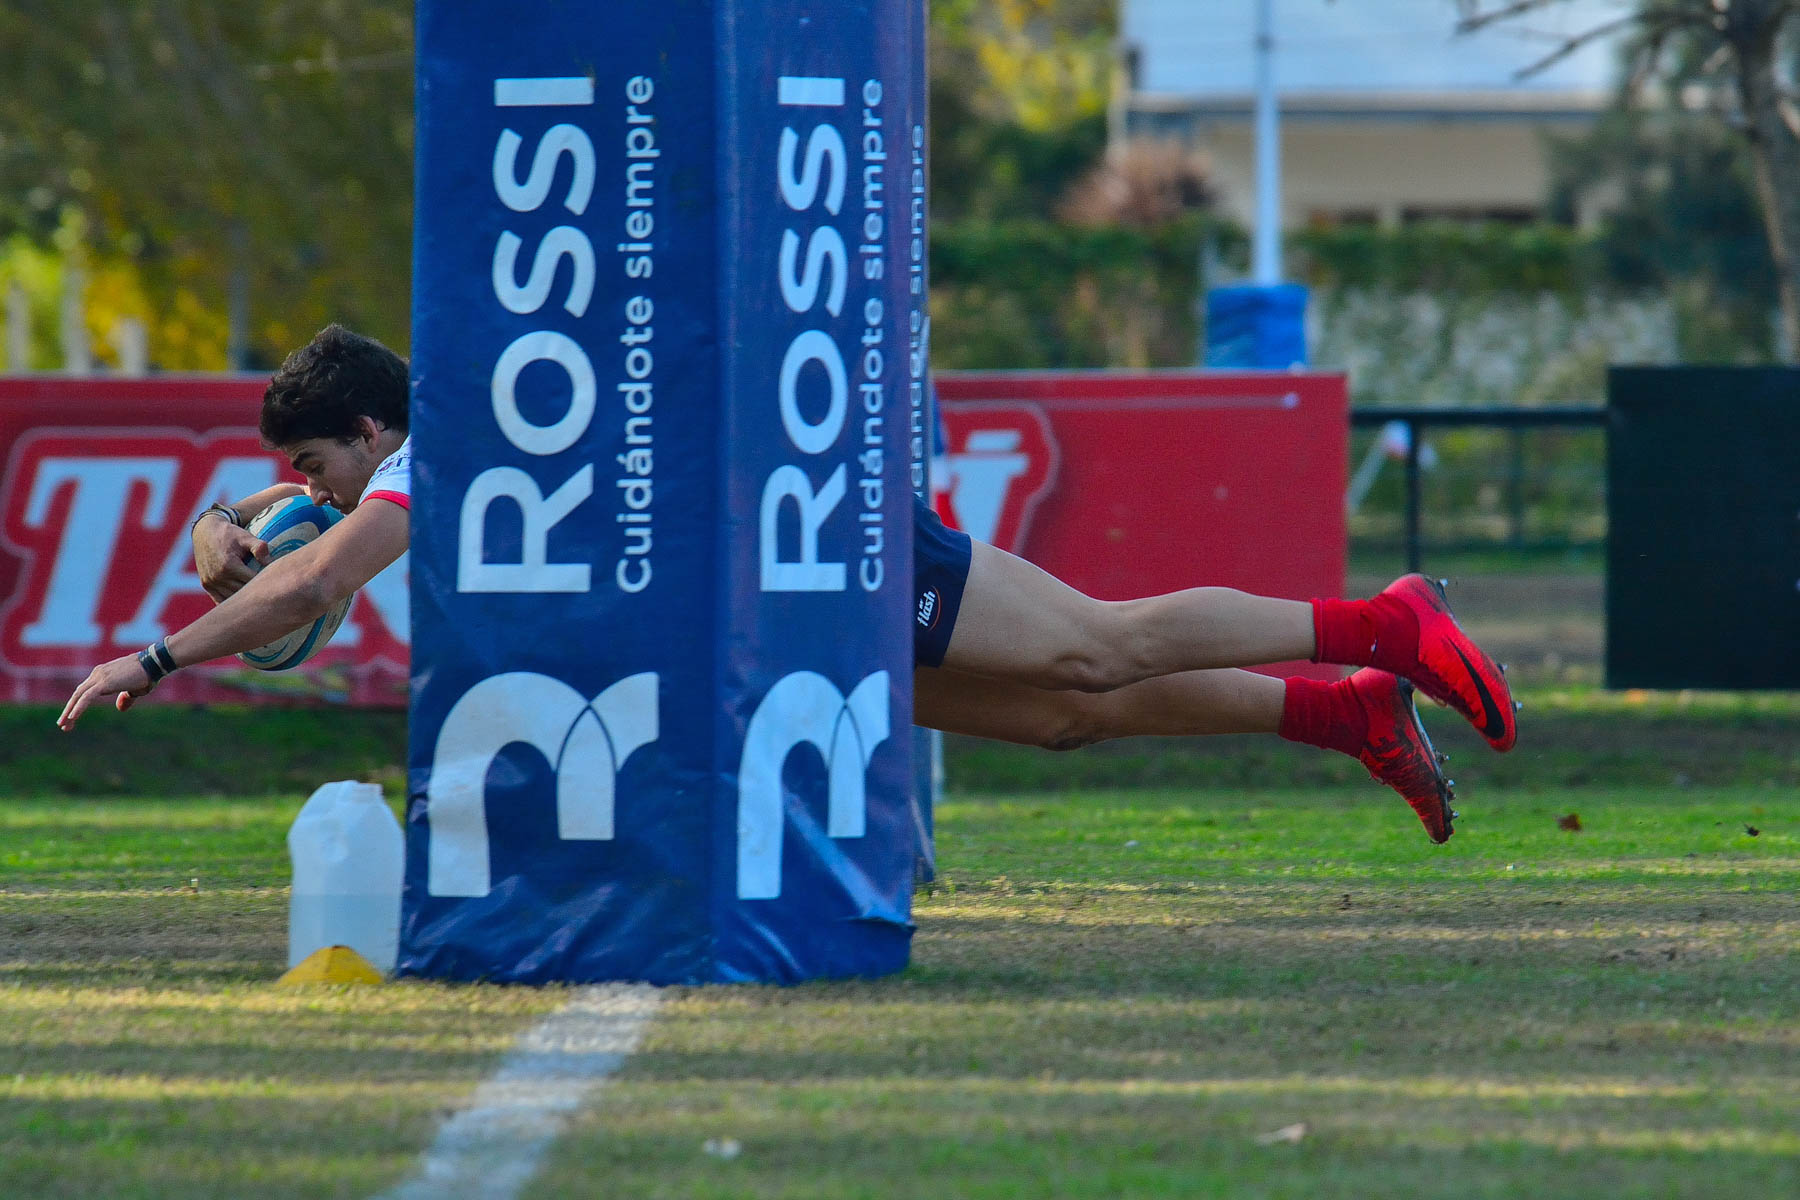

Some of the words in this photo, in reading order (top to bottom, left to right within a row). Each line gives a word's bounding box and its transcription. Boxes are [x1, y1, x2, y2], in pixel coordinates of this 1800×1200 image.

[617, 75, 660, 279] siempre
[859, 78, 888, 280] siempre
[456, 76, 597, 593] ROSSI
[616, 295, 654, 593] Cuidándote
[760, 76, 848, 592] ROSSI
[859, 297, 884, 592] Cuidándote
